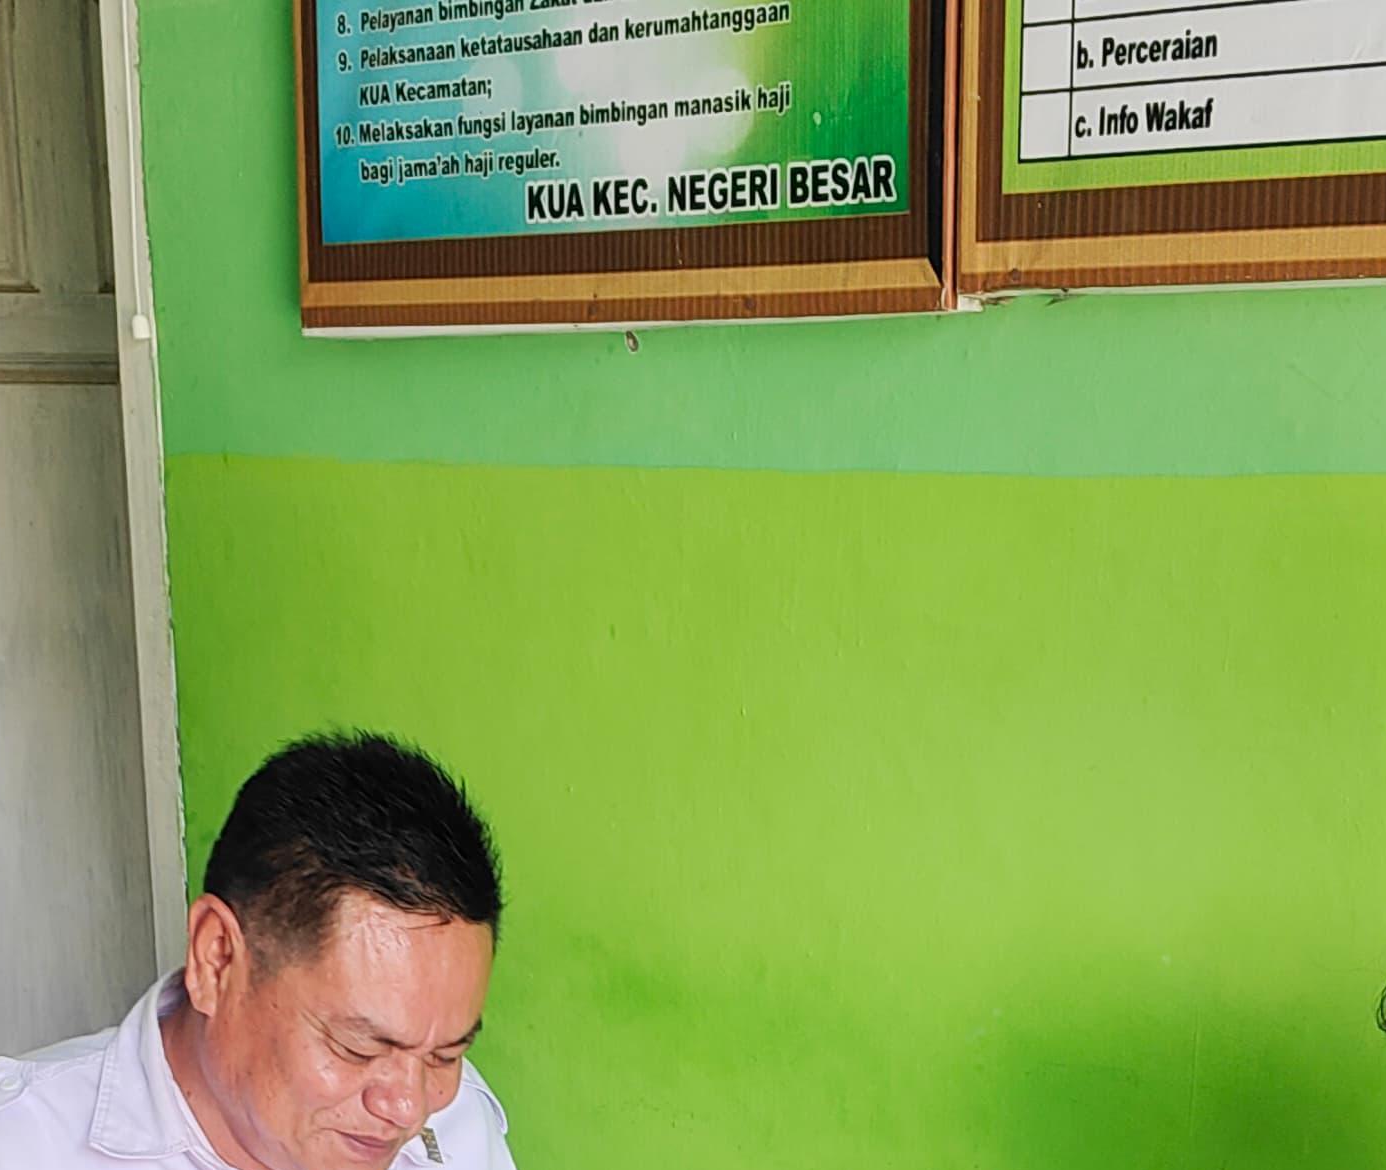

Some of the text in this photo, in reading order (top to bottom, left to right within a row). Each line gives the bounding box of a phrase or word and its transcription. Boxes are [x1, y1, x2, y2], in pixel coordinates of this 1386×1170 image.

[337, 14, 351, 34] 8.
[360, 8, 433, 33] Pelayanan
[439, 0, 524, 20] bimbingan
[338, 3, 790, 71] 9. Pelaksanaan ketatausahaan dan kerumahtanggaan
[1076, 30, 1218, 69] b. Perceraian
[360, 78, 492, 106] KUA Kecamatan;
[335, 84, 790, 145] 10. Melaksakan fungsi layanan bimbingan manasik haji
[1075, 114, 1092, 137] c.
[1099, 105, 1138, 136] Info
[1146, 98, 1214, 132] Wakaf
[360, 148, 560, 184] bagi jama'ah haji reguler.
[527, 160, 894, 219] KUA KEC. NEGERI BESAR
